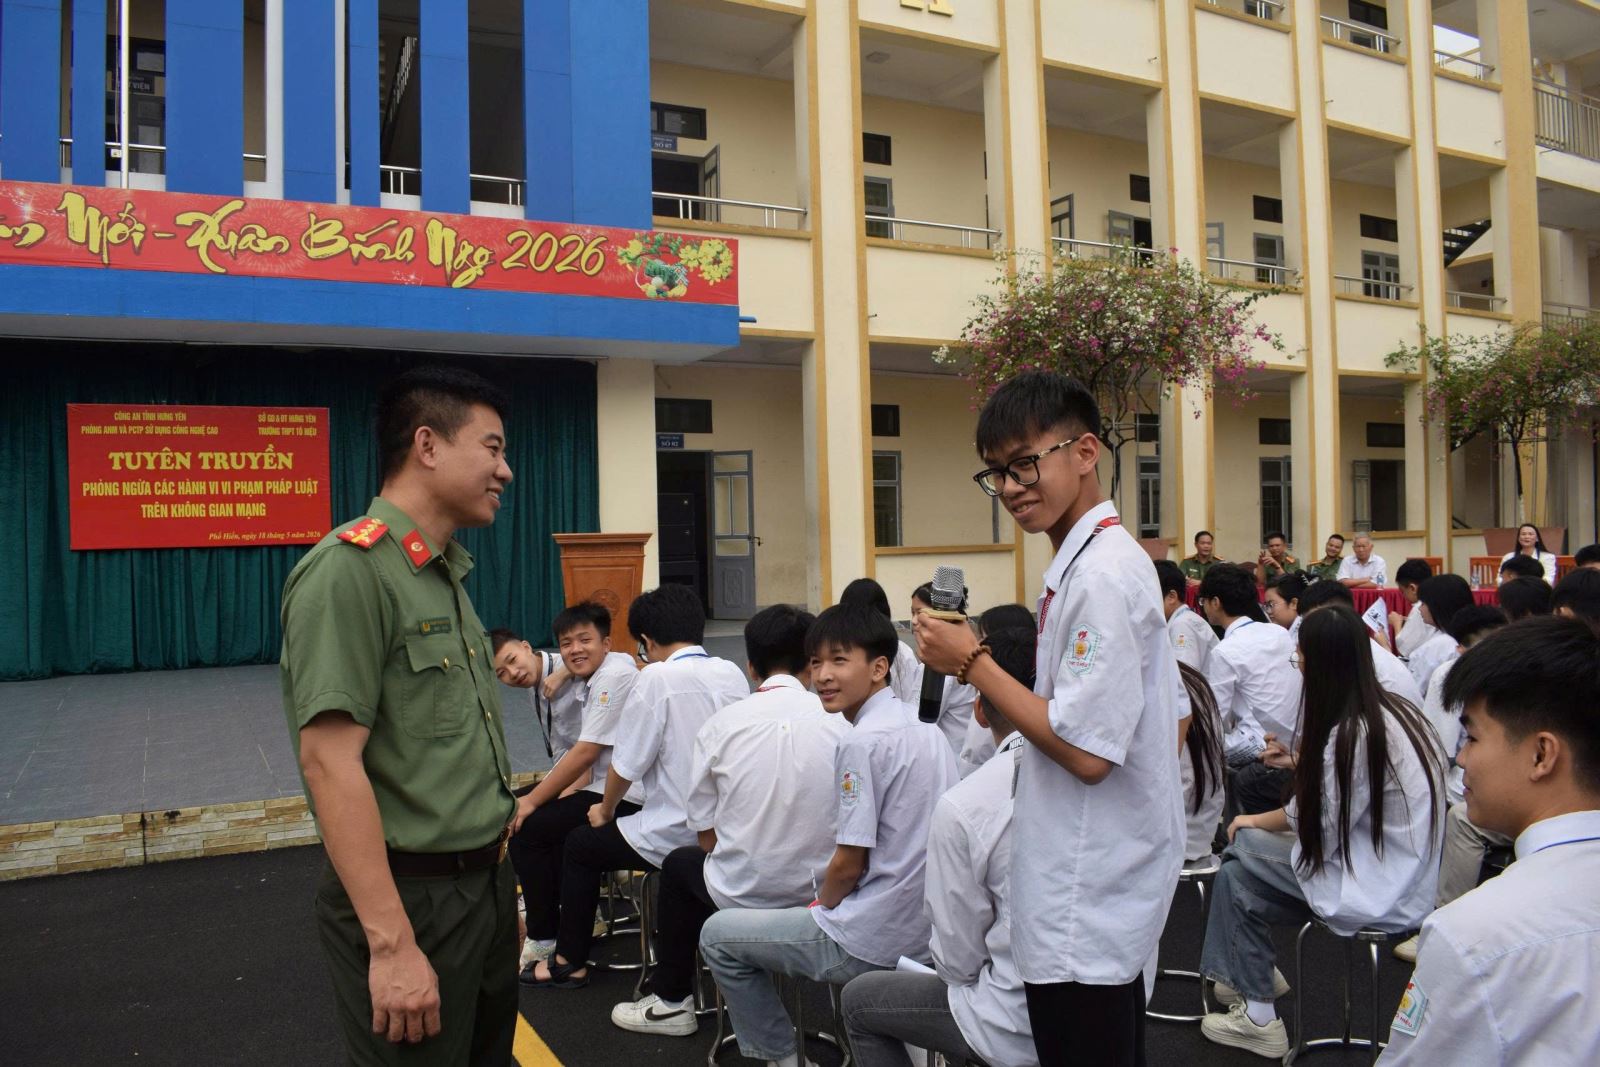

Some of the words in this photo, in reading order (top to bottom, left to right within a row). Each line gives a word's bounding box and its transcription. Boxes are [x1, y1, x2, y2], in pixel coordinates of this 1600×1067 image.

[56, 191, 146, 266] Mới
[175, 199, 290, 274] Xuân
[301, 212, 416, 265] Bính
[501, 228, 610, 277] 2026
[108, 446, 192, 470] TUYÊN
[198, 443, 294, 470] TRUYỀN
[82, 478, 120, 496] PHÒNG
[122, 478, 152, 496] NGỪA
[154, 478, 175, 495] CÁC
[177, 478, 206, 495] HÀNH
[208, 480, 219, 495] VI
[221, 480, 231, 495] VI
[233, 480, 264, 498] PHẠM
[265, 478, 293, 495] PHÁP
[294, 478, 319, 497] LUẬT
[141, 501, 169, 518] TRÊN
[170, 500, 206, 518] KHÔNG
[208, 503, 233, 517] GIAN
[235, 502, 267, 520] MẠNG
